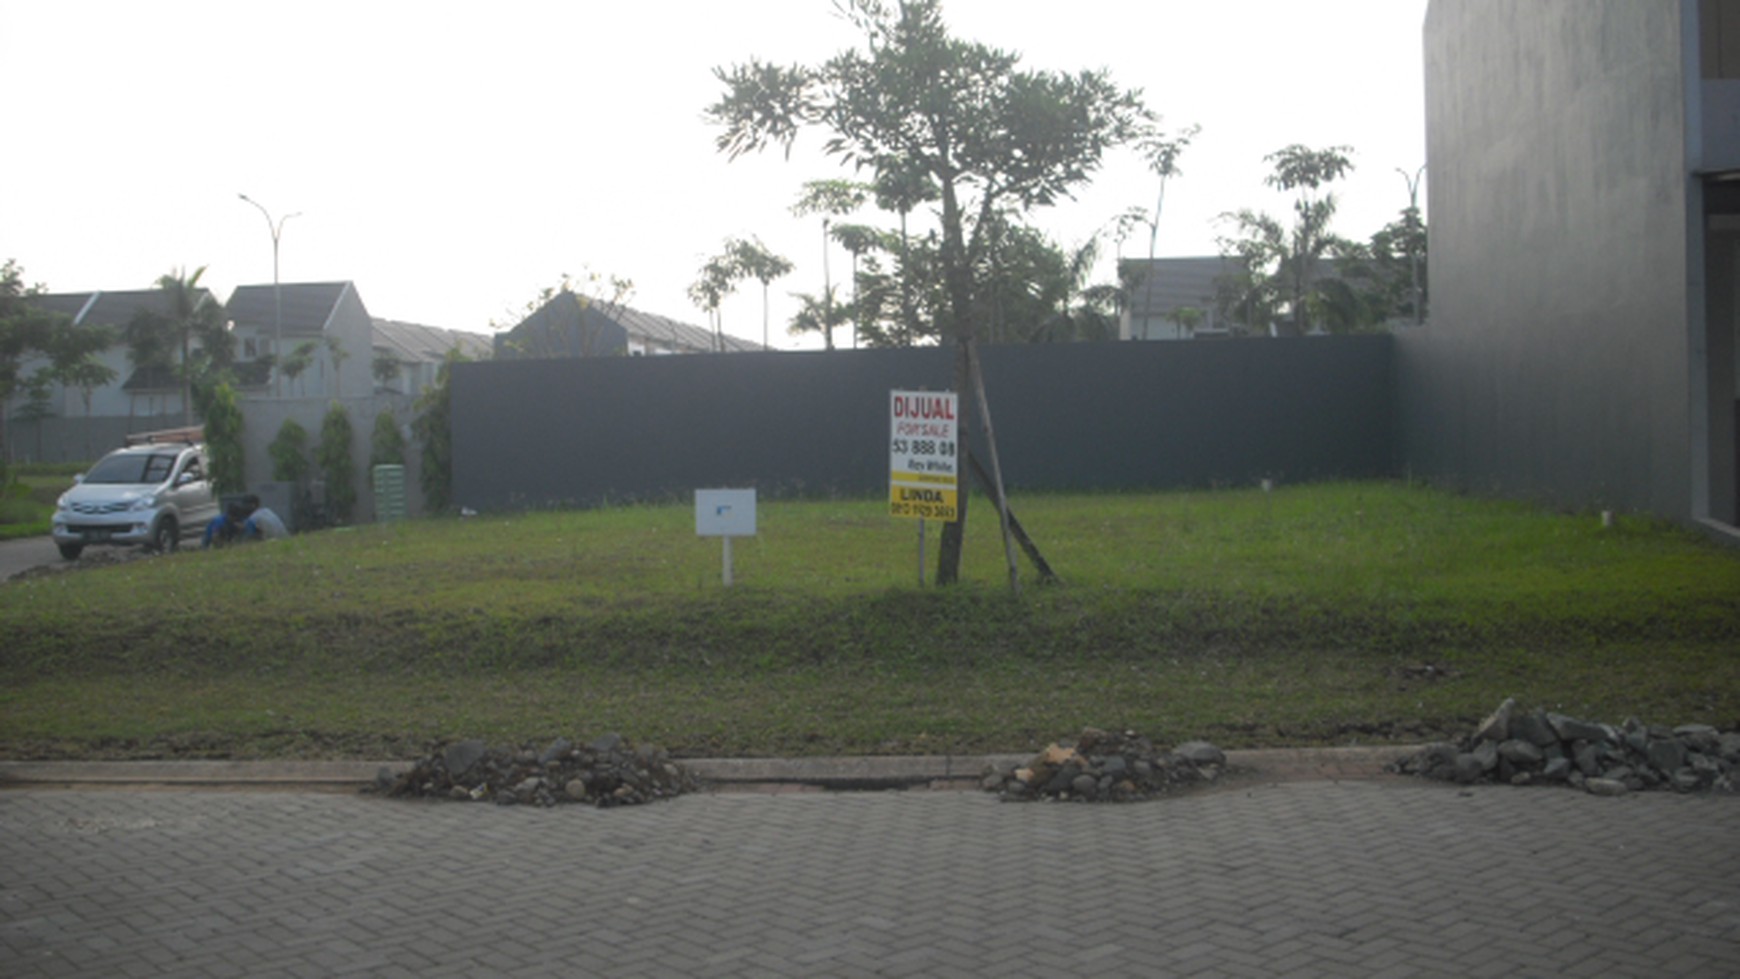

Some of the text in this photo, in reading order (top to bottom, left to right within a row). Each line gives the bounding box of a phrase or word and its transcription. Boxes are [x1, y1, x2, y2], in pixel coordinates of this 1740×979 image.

[894, 396, 955, 420] DIJUAL
[921, 423, 950, 438] SALE
[900, 488, 944, 503] LINDA
